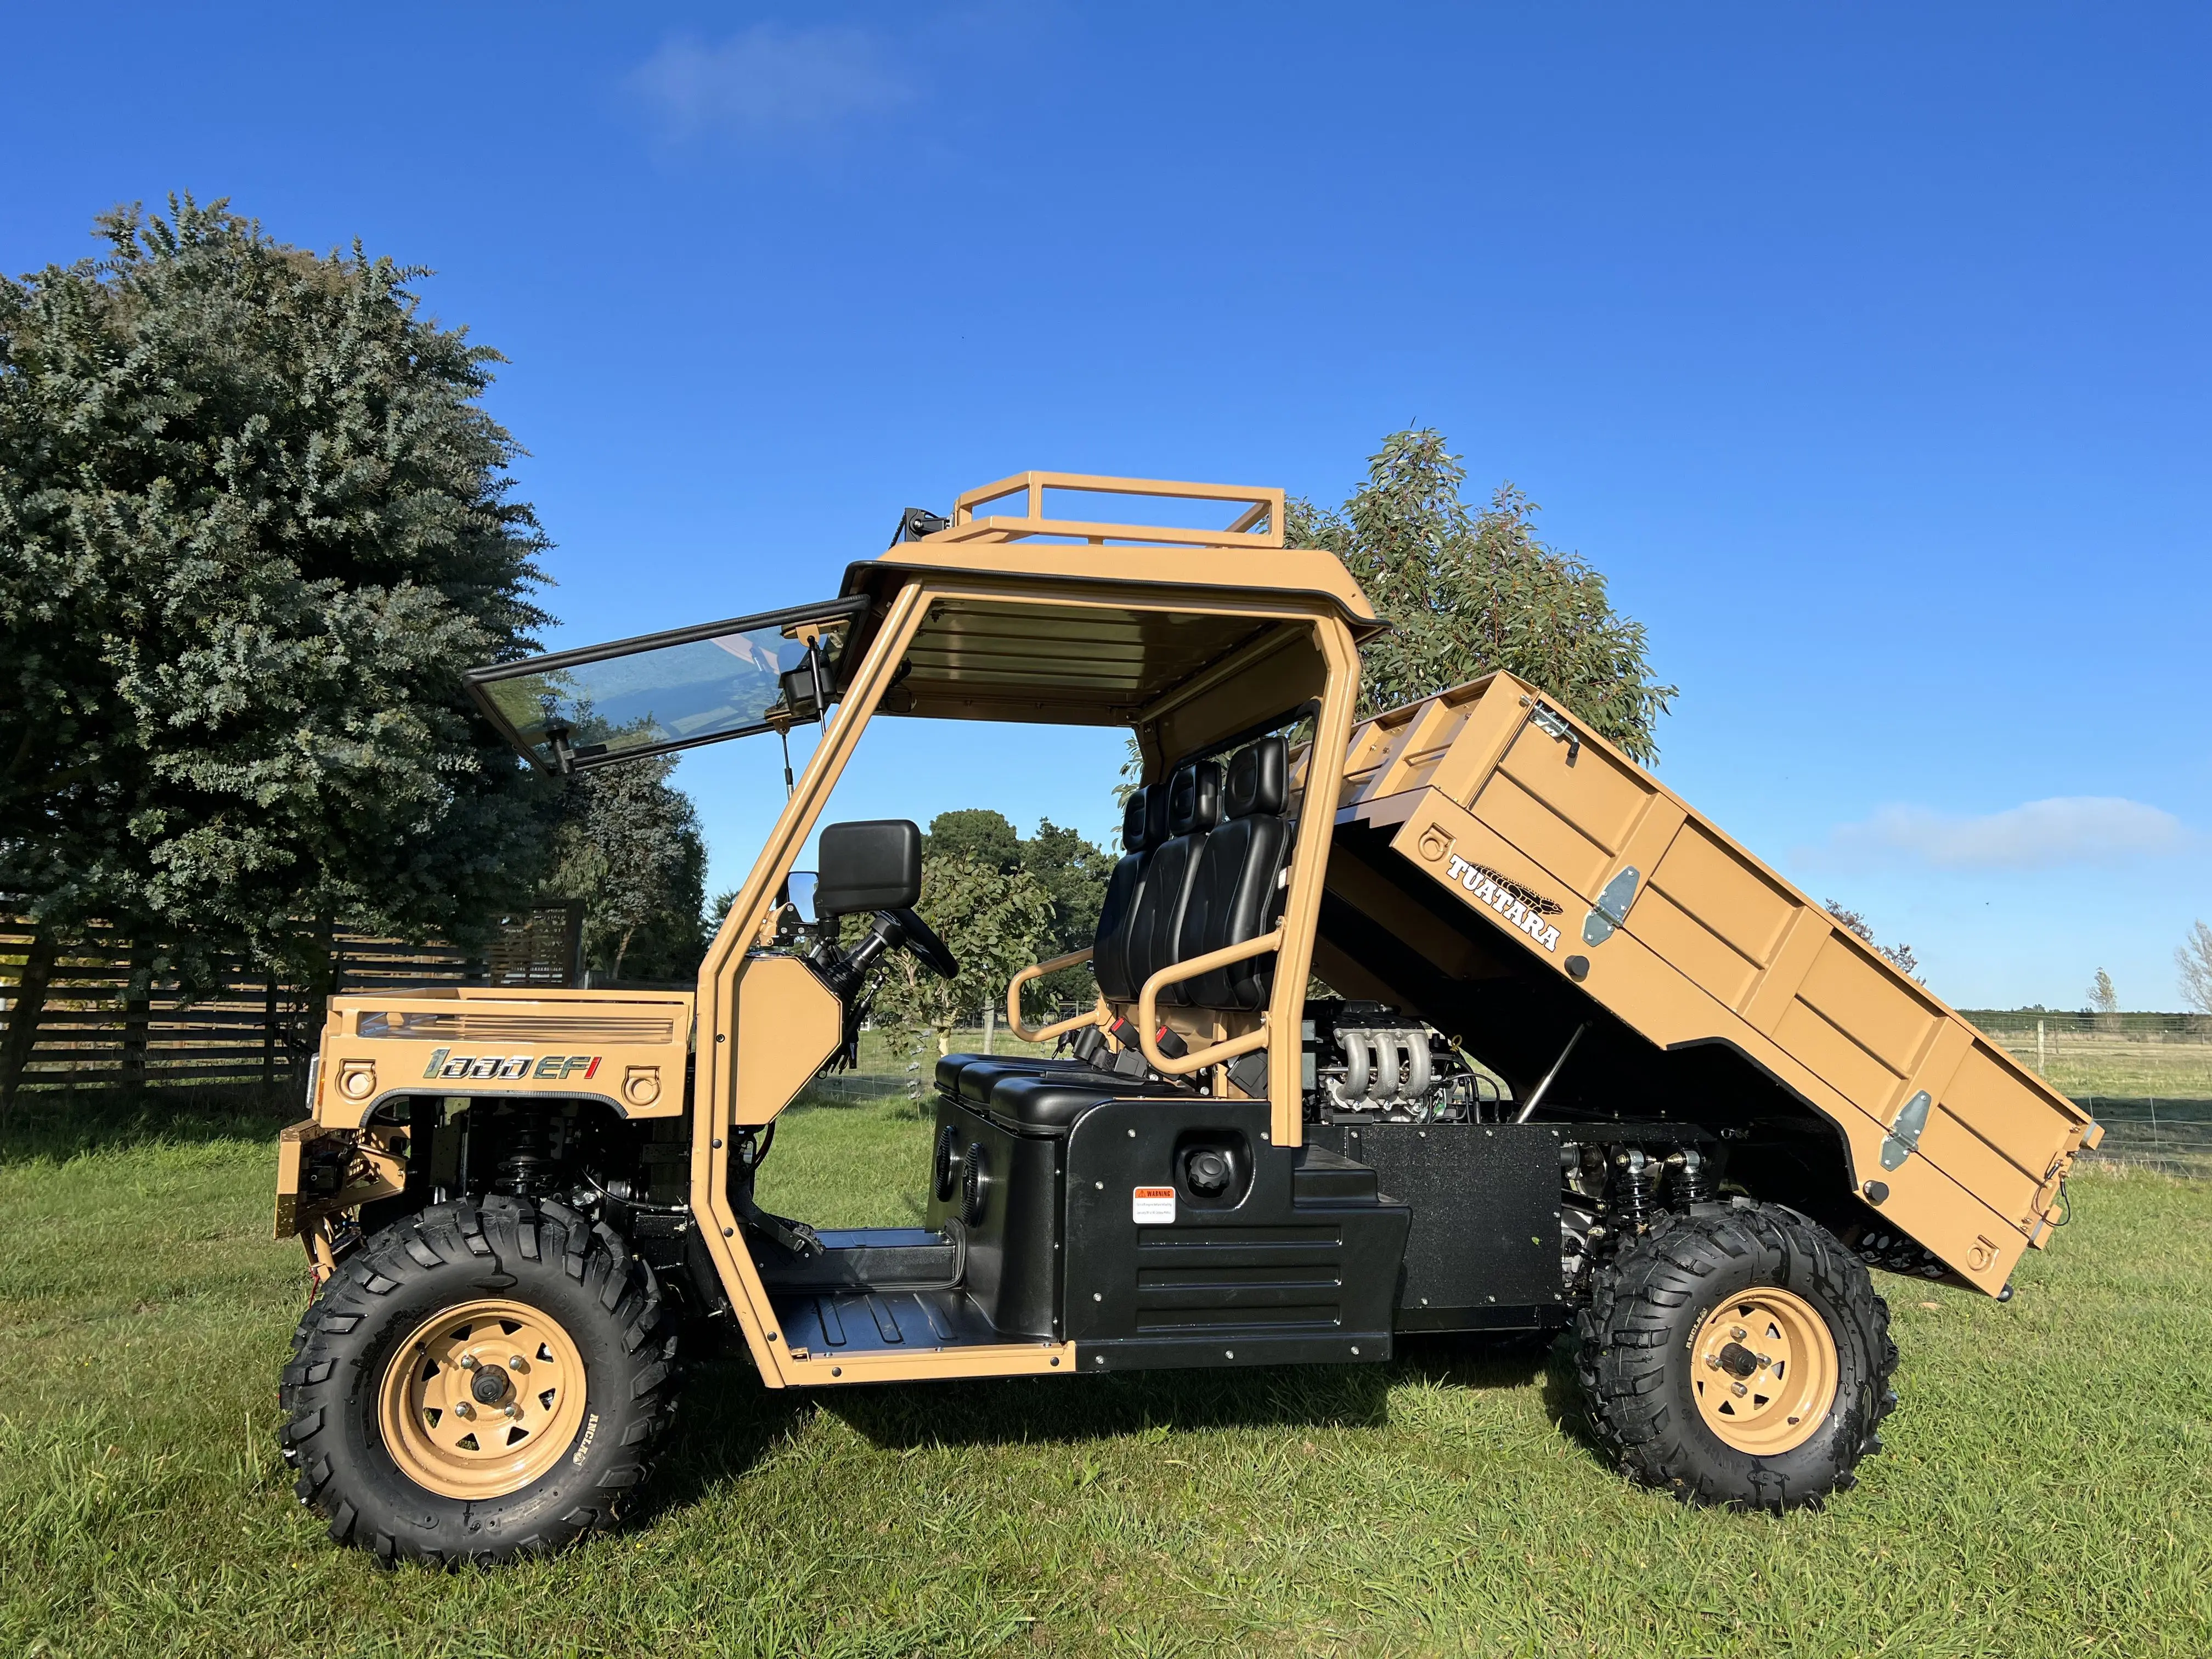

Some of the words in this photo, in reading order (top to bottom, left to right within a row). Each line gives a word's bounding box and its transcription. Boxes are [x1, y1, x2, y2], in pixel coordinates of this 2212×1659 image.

[1446, 854, 1561, 952] TUATARA
[423, 1047, 534, 1079] 1000
[1686, 1317, 1703, 1349] ANCLA
[578, 1413, 599, 1455] ANCLA
